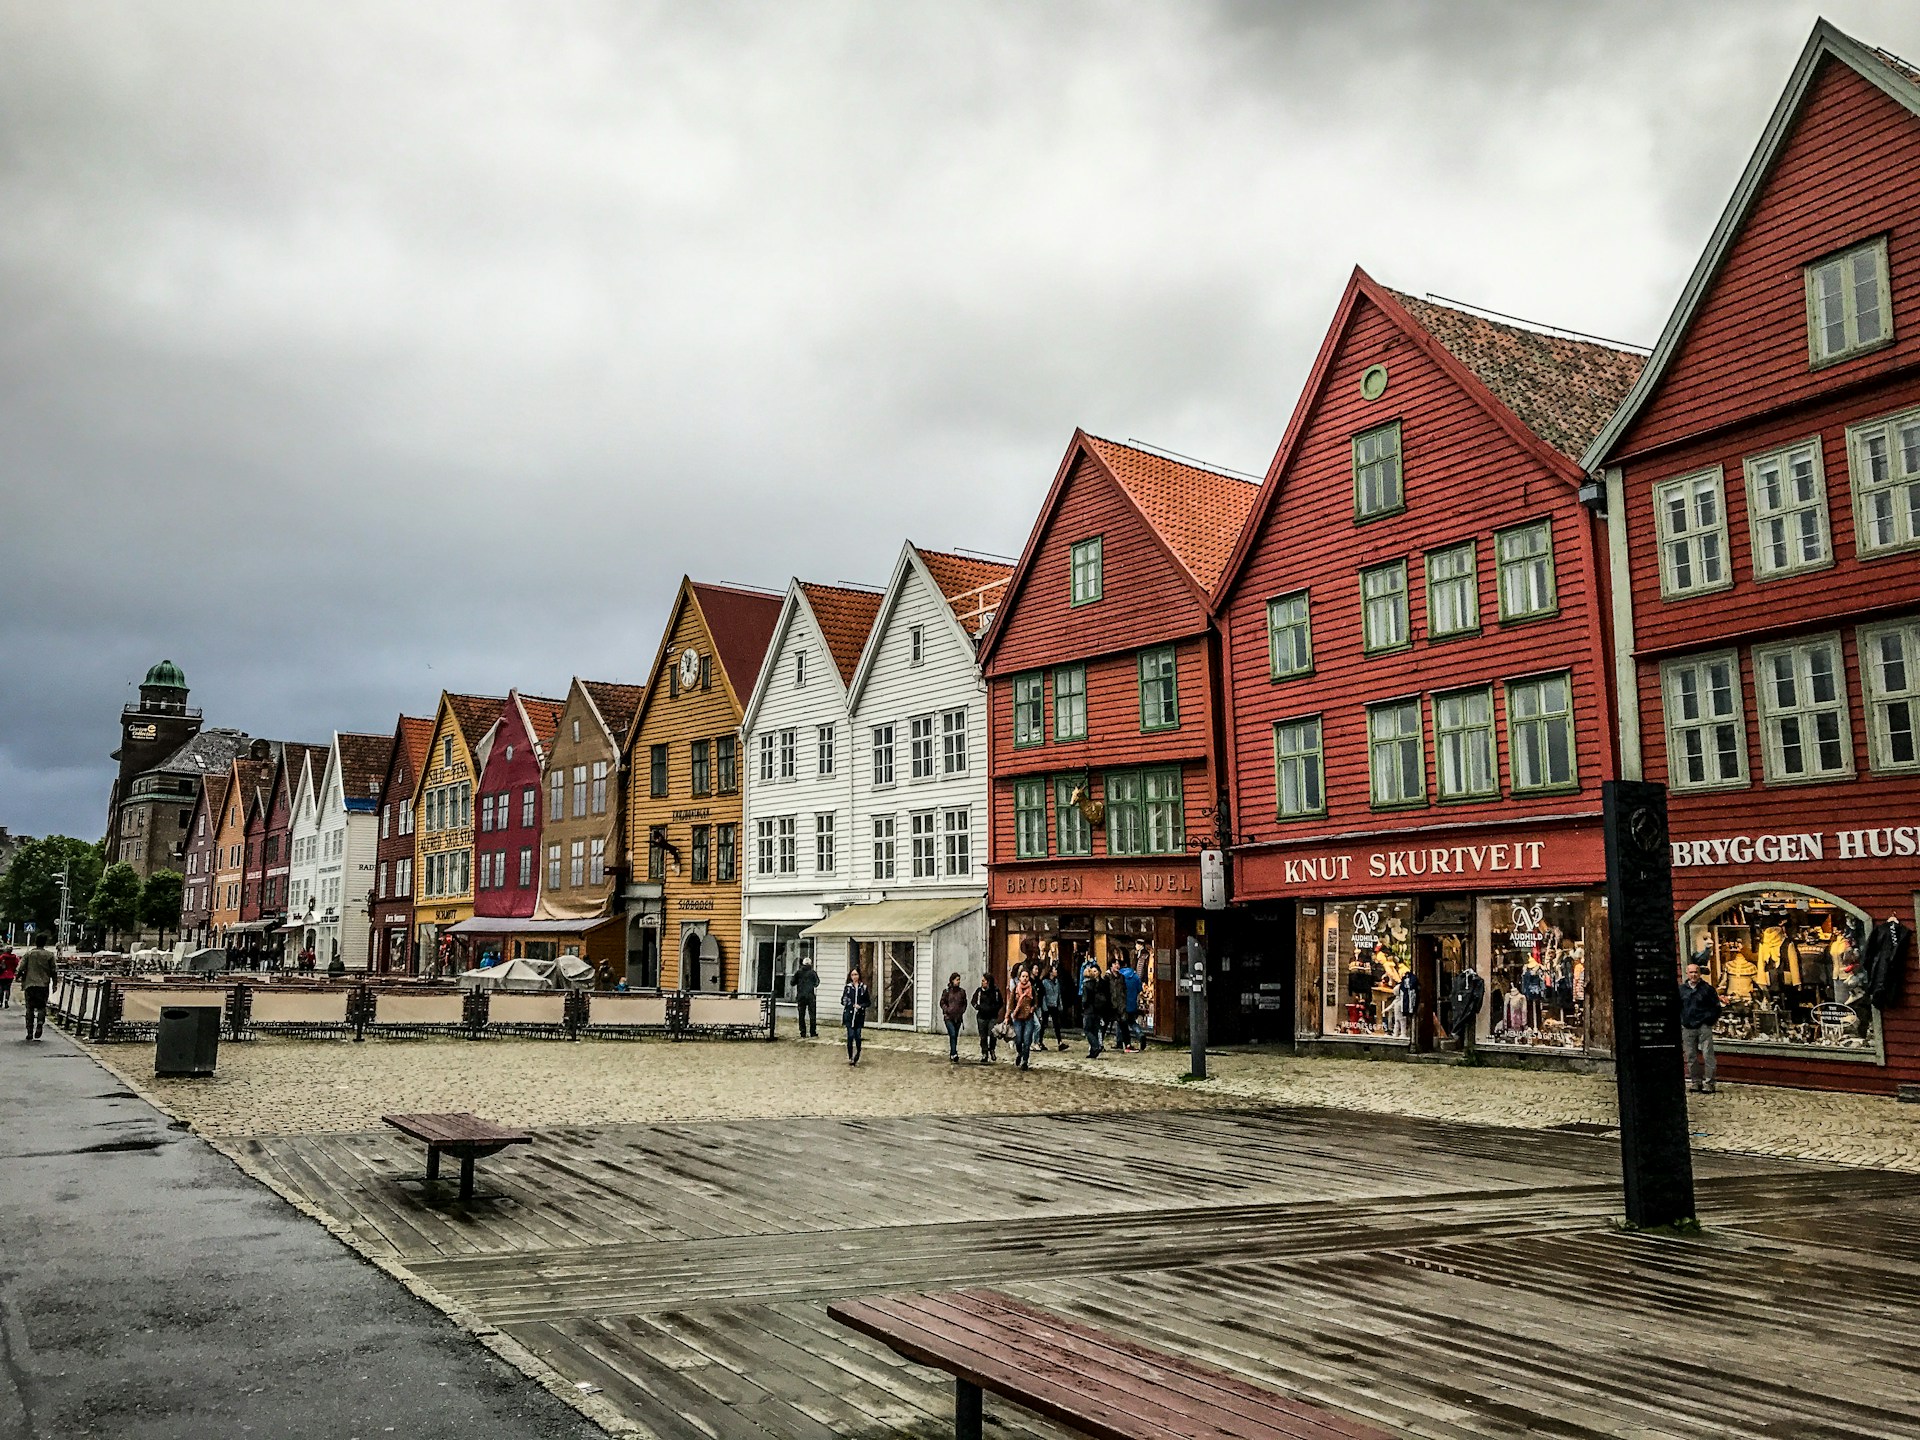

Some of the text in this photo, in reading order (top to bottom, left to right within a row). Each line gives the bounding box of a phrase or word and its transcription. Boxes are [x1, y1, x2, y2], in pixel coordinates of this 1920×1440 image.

[1671, 826, 1920, 867] BRYGGEN HUS
[1284, 842, 1546, 884] KNUT SKURTVEIT
[1006, 875, 1083, 894] BRYGGEN
[1114, 874, 1193, 893] HANDEL
[1351, 934, 1378, 942] AUDHILD
[1510, 932, 1543, 941] AUDHILD
[1354, 941, 1373, 949] VIKEN
[1514, 940, 1536, 948] VIKEN
[1341, 1021, 1368, 1030] MEMORIES
[1504, 1030, 1537, 1039] MEMORIES
